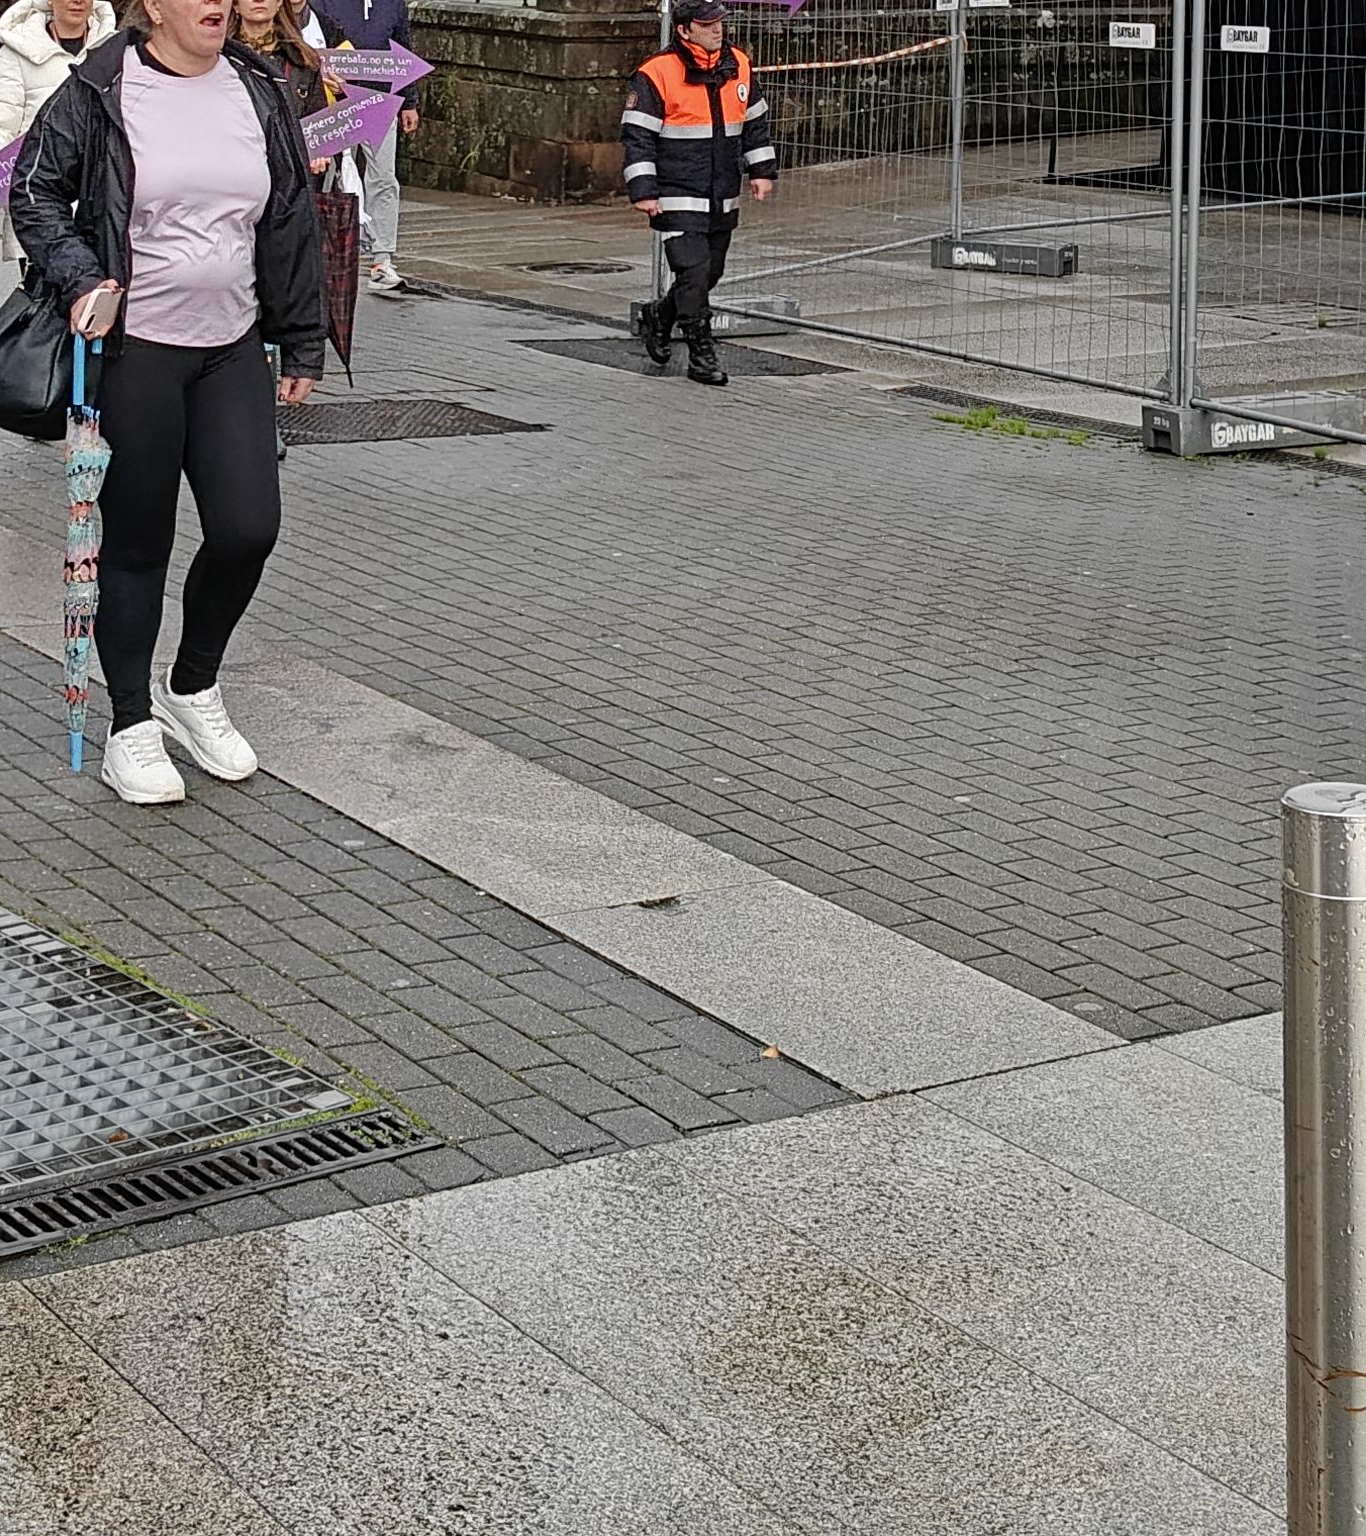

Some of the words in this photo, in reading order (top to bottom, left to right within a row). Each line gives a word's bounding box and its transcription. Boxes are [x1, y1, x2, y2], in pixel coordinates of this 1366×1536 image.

[363, 66, 407, 76] machista
[383, 57, 394, 65] es
[397, 58, 412, 66] un
[302, 116, 336, 139] género
[337, 93, 385, 119] comienza
[308, 134, 321, 150] el
[322, 118, 364, 142] respeto
